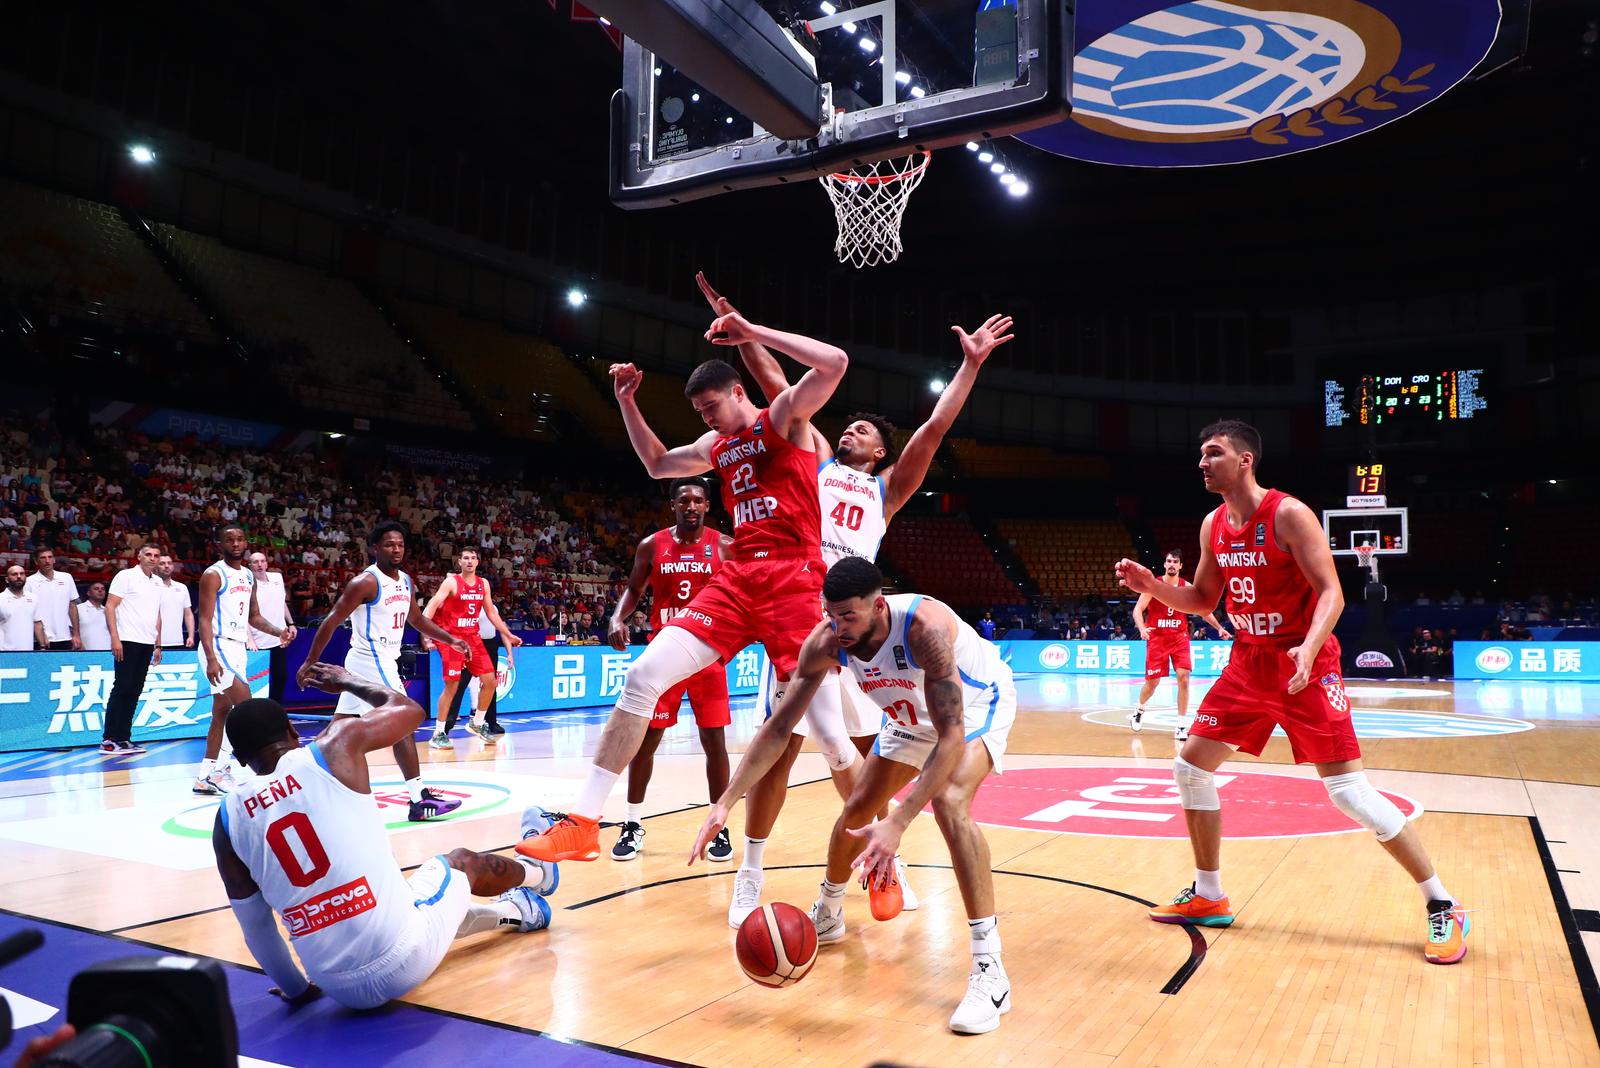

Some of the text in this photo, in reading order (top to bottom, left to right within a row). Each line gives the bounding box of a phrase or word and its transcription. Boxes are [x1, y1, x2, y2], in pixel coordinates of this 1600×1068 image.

[1384, 374, 1430, 386] DOM CRO
[1385, 395, 1431, 407] 20 2 23
[168, 415, 254, 441] PIRAEUS
[717, 439, 767, 468] HRVATSKA
[731, 463, 758, 495] 22
[1356, 463, 1383, 477] 6:18
[1360, 476, 1379, 493] 13
[740, 496, 778, 523] HEP
[830, 501, 864, 532] 40
[754, 551, 769, 559] HRV
[1216, 551, 1267, 568] HRVATSKA
[660, 561, 712, 575] HRVATSKA
[677, 579, 692, 600] 3
[1229, 576, 1256, 605] 99
[239, 601, 244, 616] 3
[468, 603, 476, 615] 5
[687, 609, 713, 626] HPB
[391, 612, 405, 630] 10
[1076, 645, 1131, 670] 品质
[1519, 648, 1582, 672] 品质
[654, 711, 670, 720] HPB
[1196, 713, 1218, 726] HPB
[243, 774, 303, 819] PEÑA
[265, 811, 331, 888] 0
[303, 883, 369, 917] brava
[311, 897, 374, 927] lubricants
